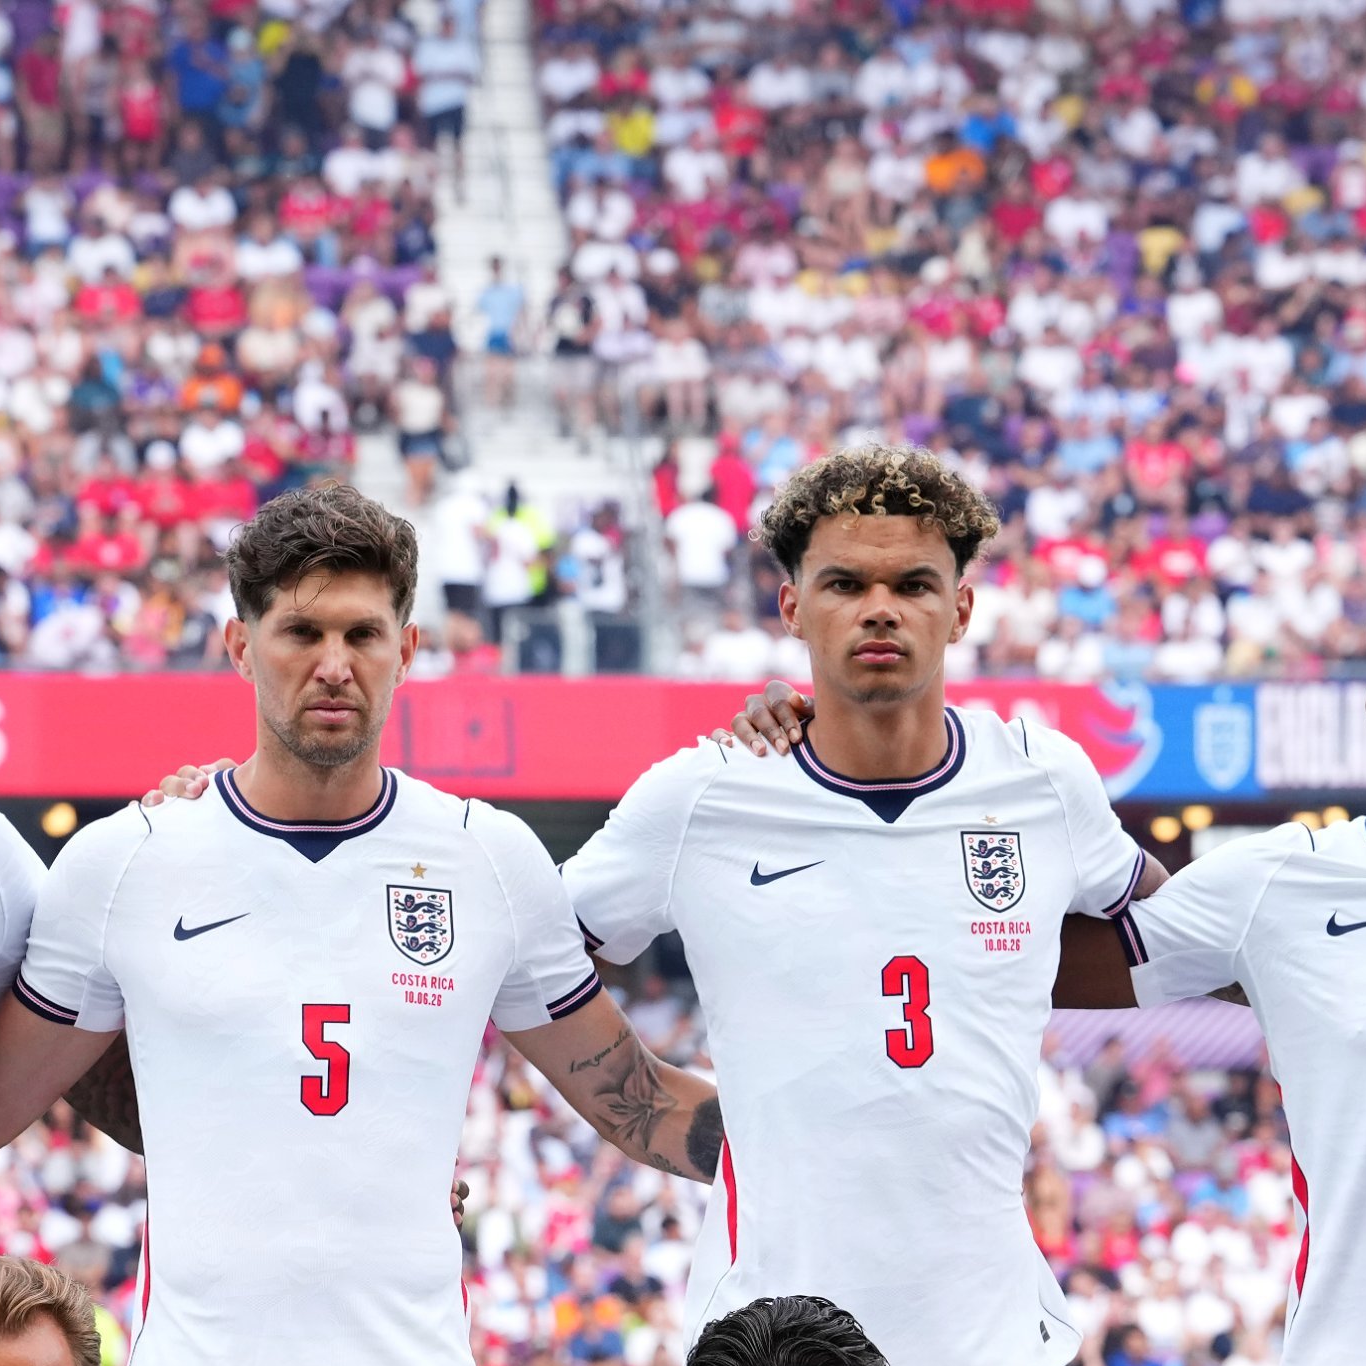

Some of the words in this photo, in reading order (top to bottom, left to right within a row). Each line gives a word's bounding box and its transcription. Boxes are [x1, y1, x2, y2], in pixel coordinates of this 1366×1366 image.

[970, 921, 1006, 935] COSTA
[1008, 921, 1031, 935] RICA
[985, 938, 1021, 952] 10.06.26
[391, 972, 428, 989] COSTA
[430, 976, 455, 991] RICA
[404, 990, 442, 1007] 10.06.26
[881, 955, 934, 1069] 3
[300, 1003, 351, 1116] 5
